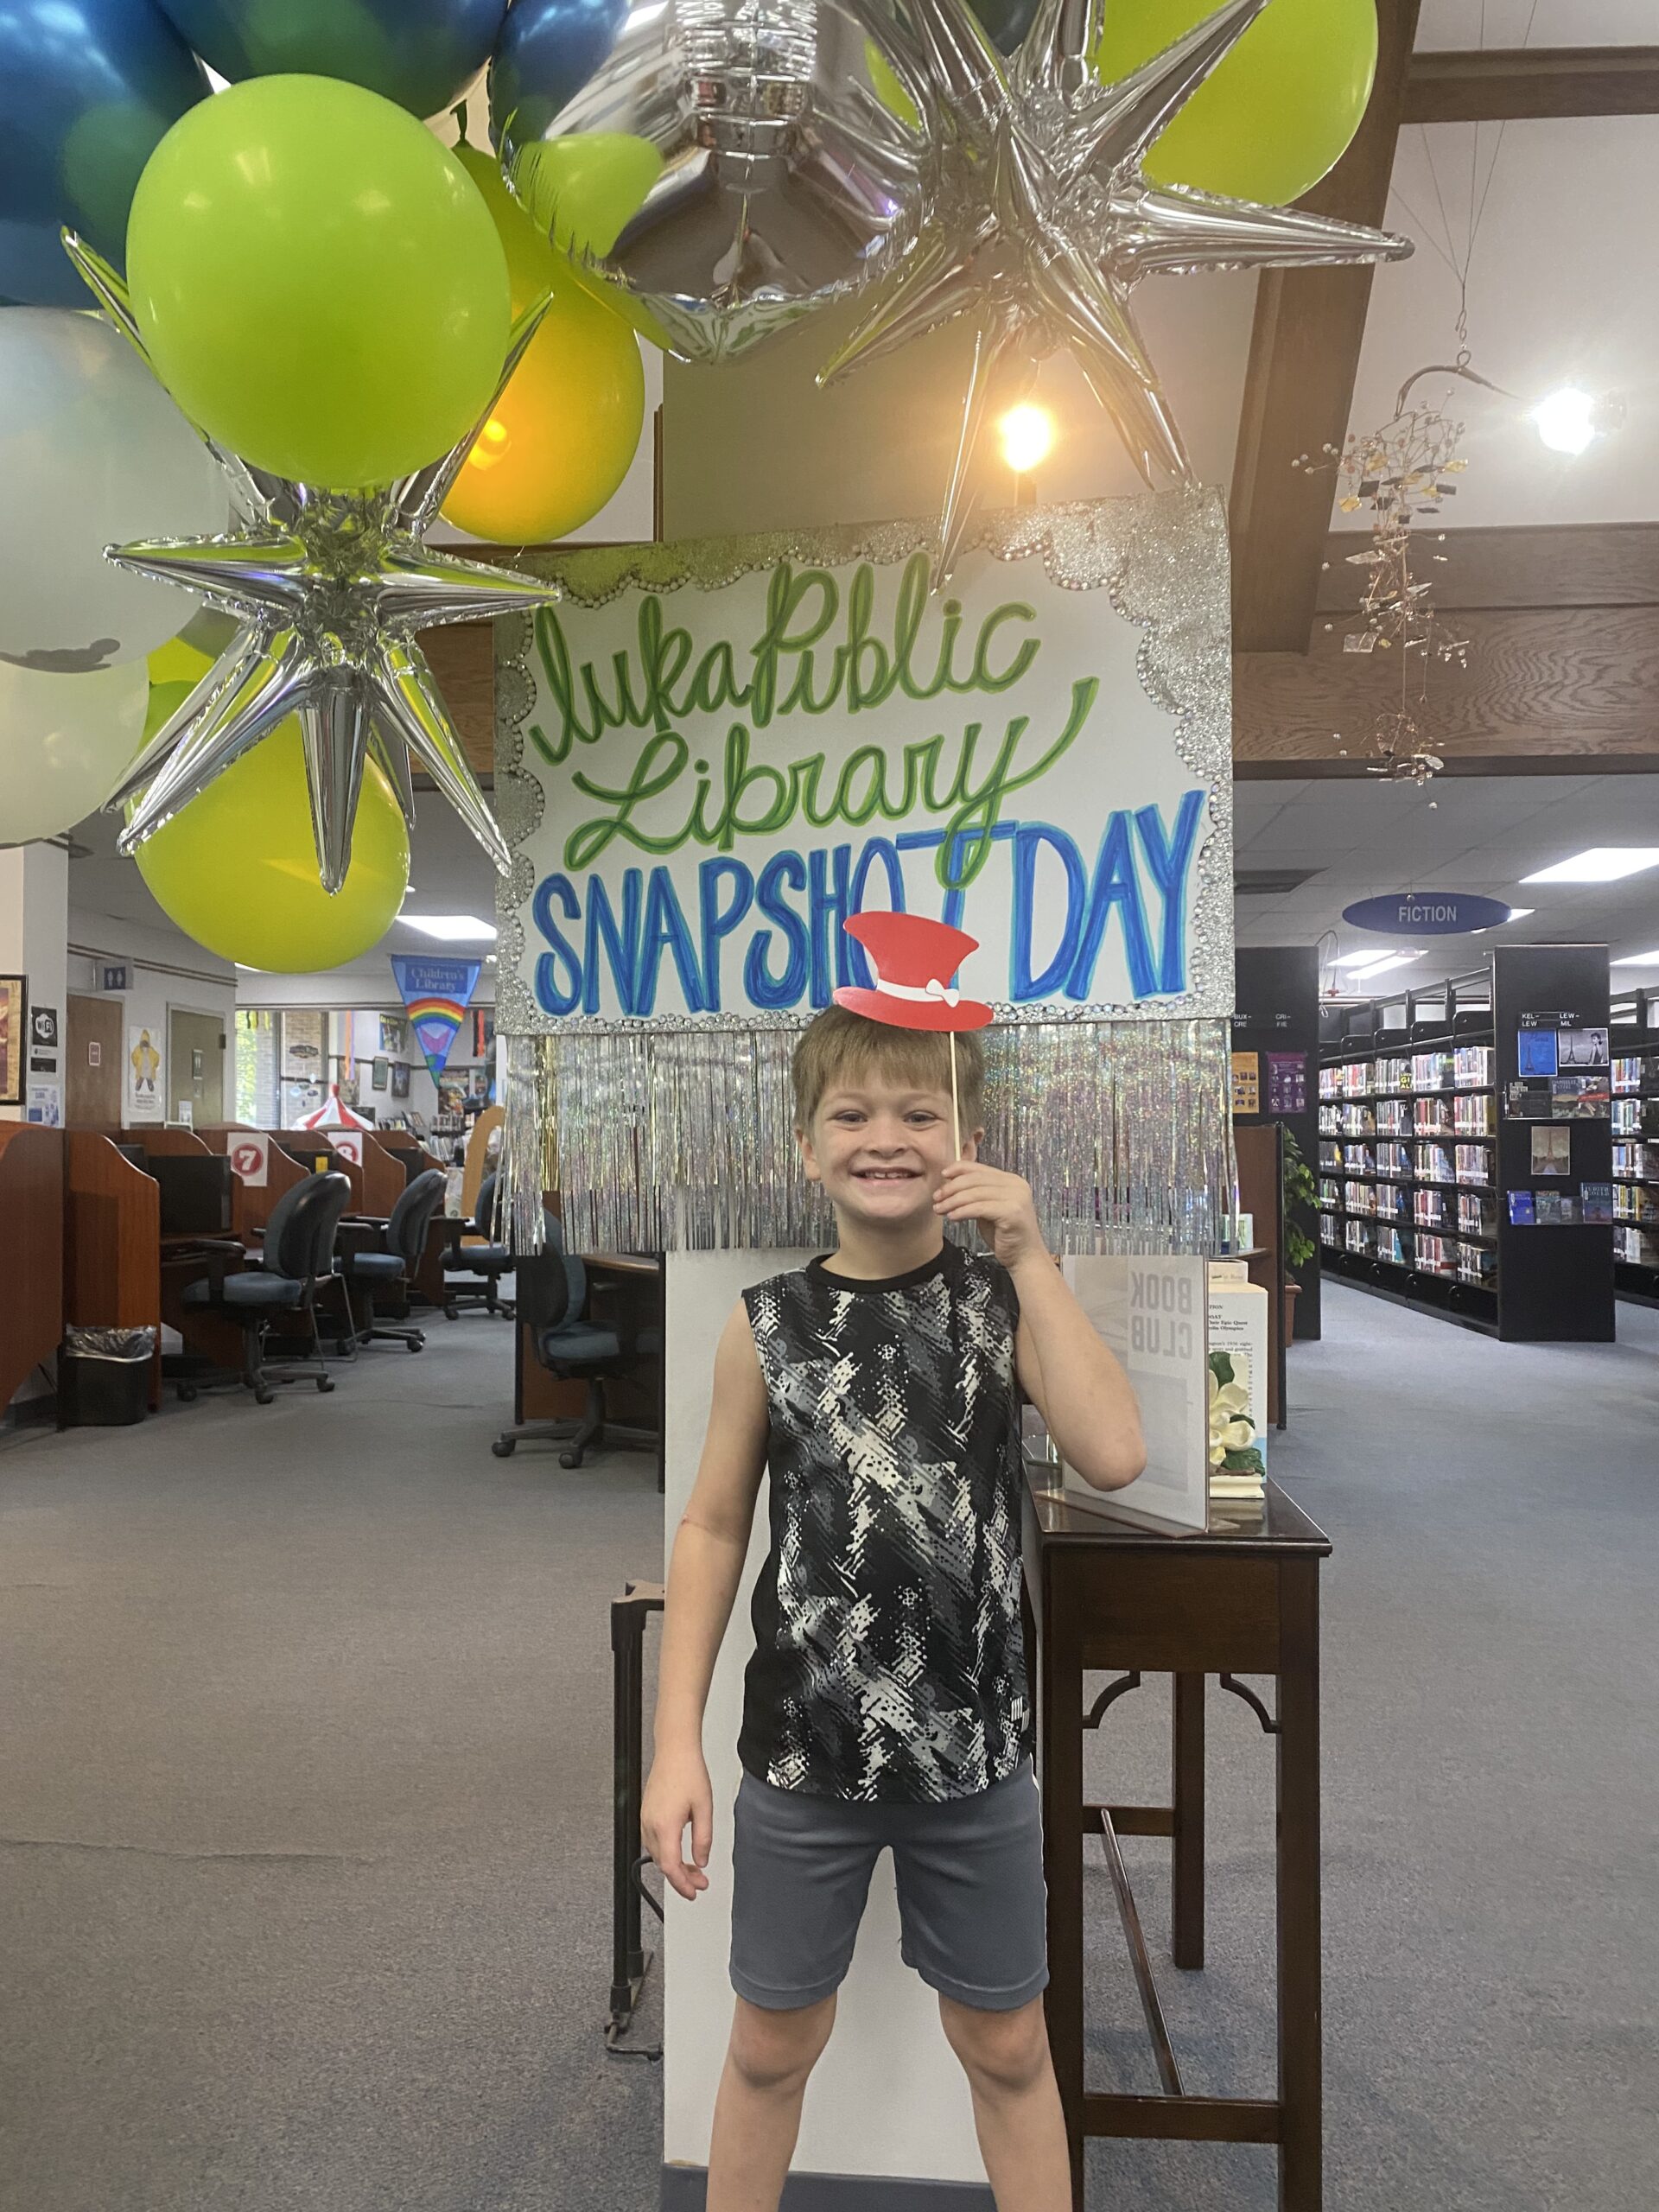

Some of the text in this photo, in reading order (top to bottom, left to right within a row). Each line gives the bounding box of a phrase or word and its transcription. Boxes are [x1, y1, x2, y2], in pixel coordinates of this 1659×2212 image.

[529, 551, 1041, 764] Iuka Public
[563, 677, 1100, 892] Library
[1010, 789, 1207, 1004] DAY
[1398, 905, 1457, 923] FICTION
[410, 967, 465, 982] Children's
[415, 978, 456, 993] Library
[238, 1149, 257, 1172] 7
